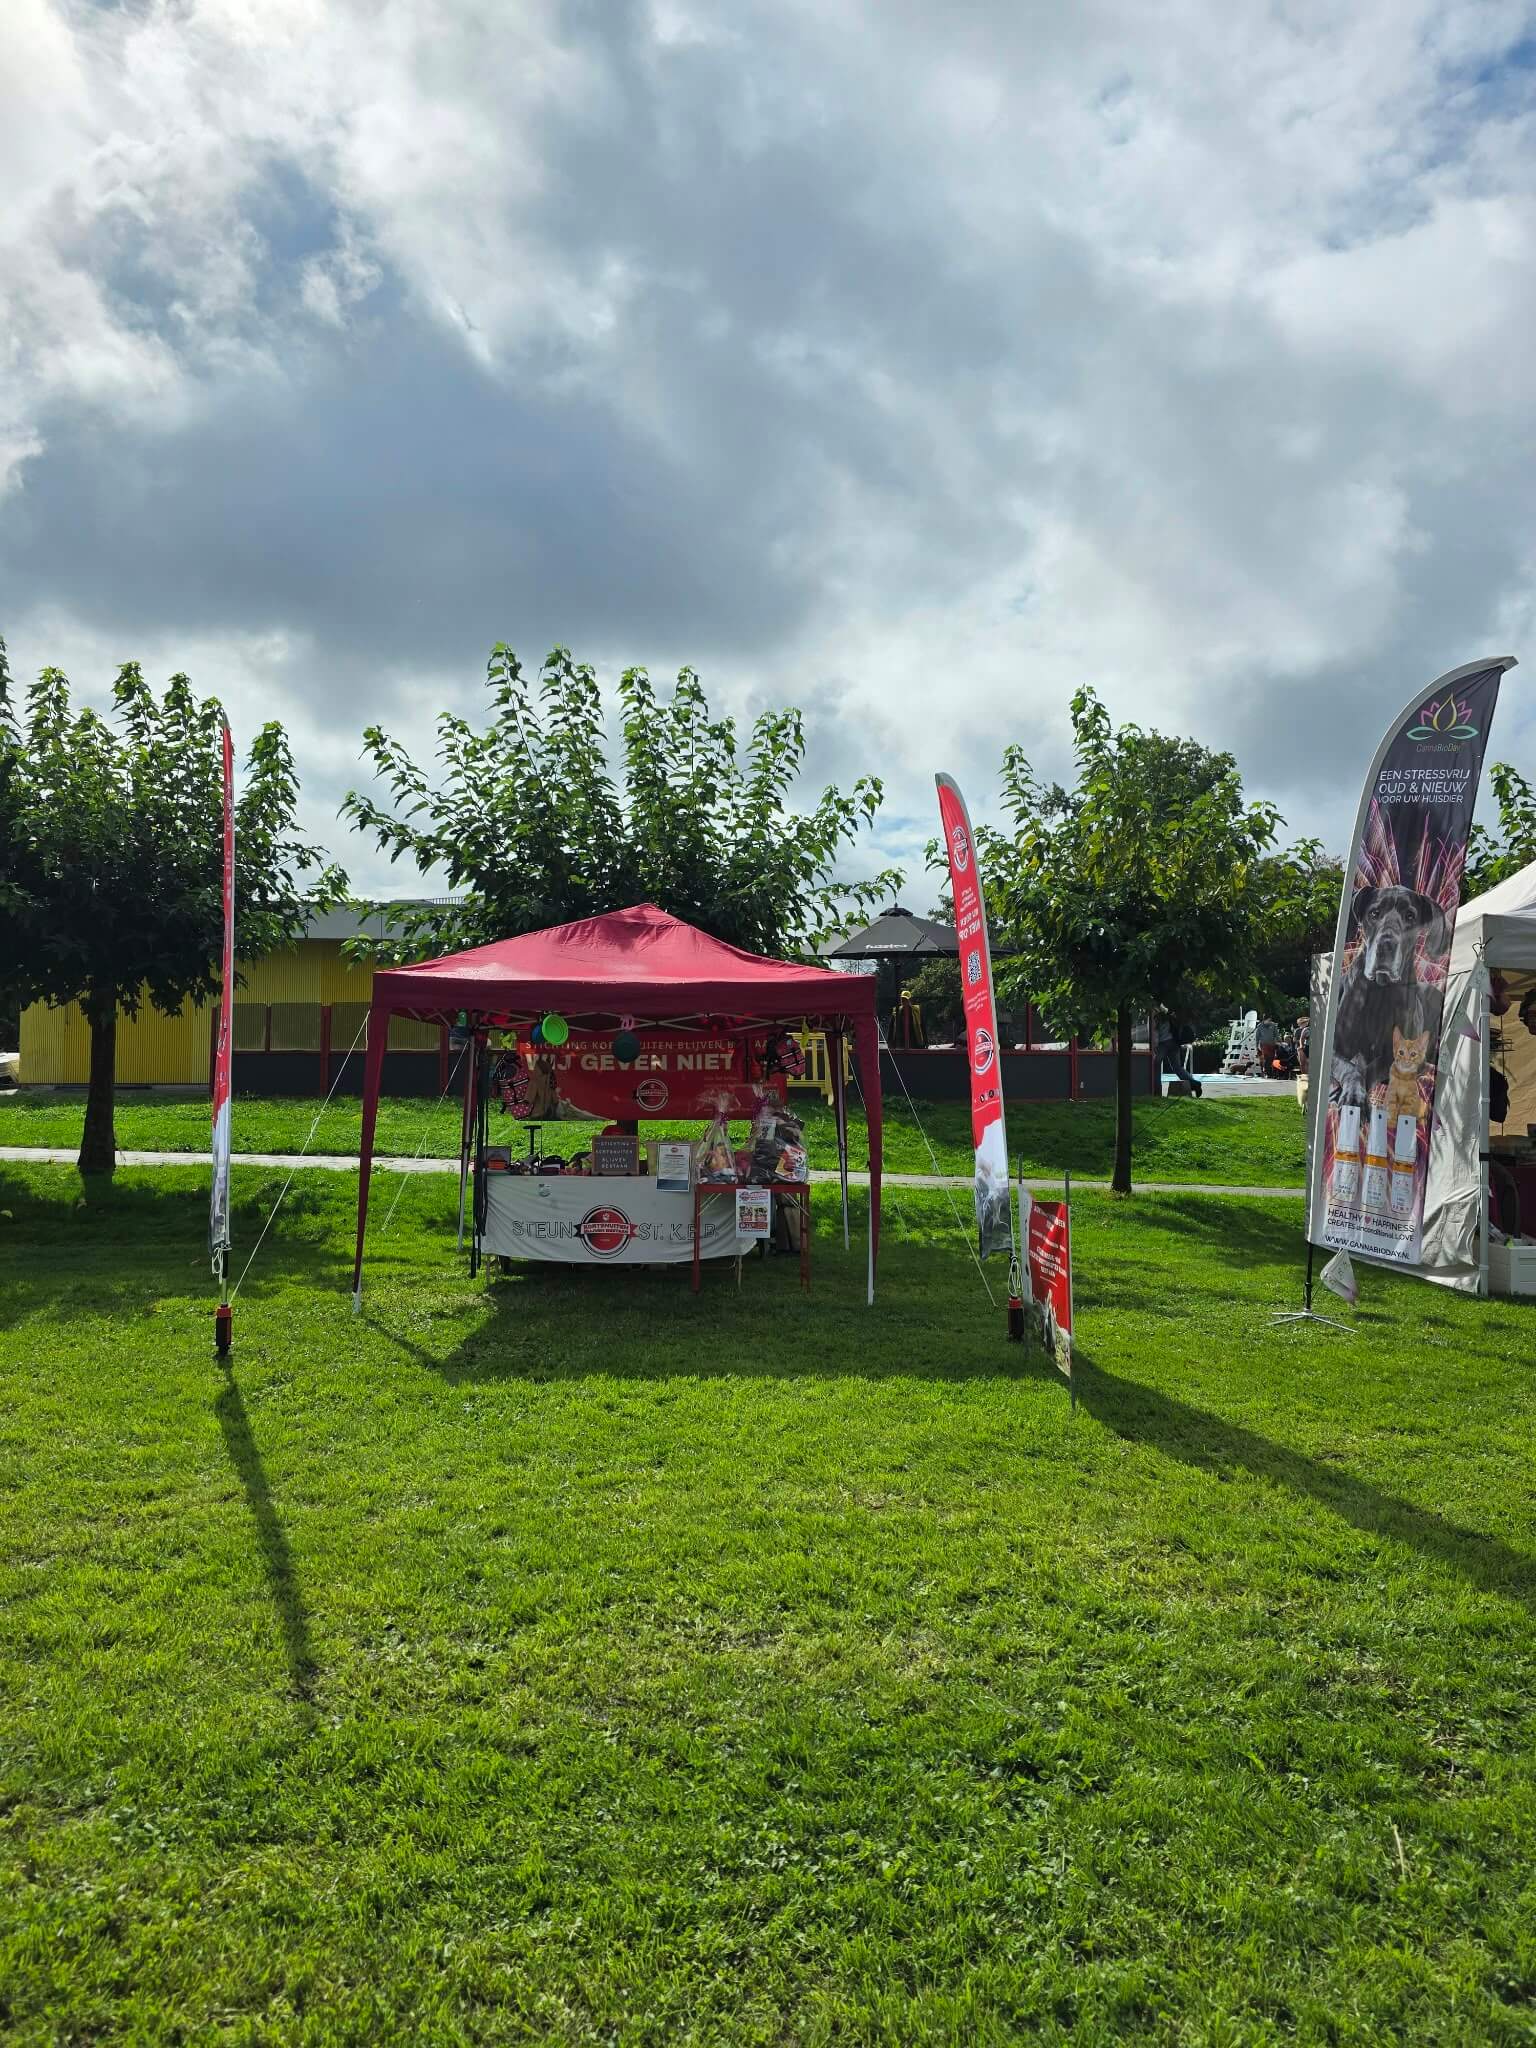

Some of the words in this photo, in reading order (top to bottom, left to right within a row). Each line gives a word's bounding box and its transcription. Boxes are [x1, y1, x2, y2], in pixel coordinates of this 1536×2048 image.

[1380, 769, 1402, 781] EEN
[1403, 768, 1471, 780] STRESSVRIJ
[1379, 782, 1406, 794] OUD
[1409, 781, 1418, 794] &
[1421, 781, 1467, 793] NIEUW
[1403, 795, 1421, 804] UW
[1421, 794, 1464, 804] HUISDIER
[592, 1040, 674, 1050] KORUITEN
[679, 1040, 721, 1050] BLIJVEN
[677, 1053, 735, 1071] NIET
[512, 1220, 573, 1239] STEUN
[1327, 1208, 1363, 1222] HEALTHY
[1372, 1218, 1415, 1233] HAPPINESS
[1327, 1218, 1355, 1230] CREATES
[1395, 1233, 1414, 1242] LOVE
[1325, 1234, 1410, 1260] WWW.CANNABIODAY.NL
